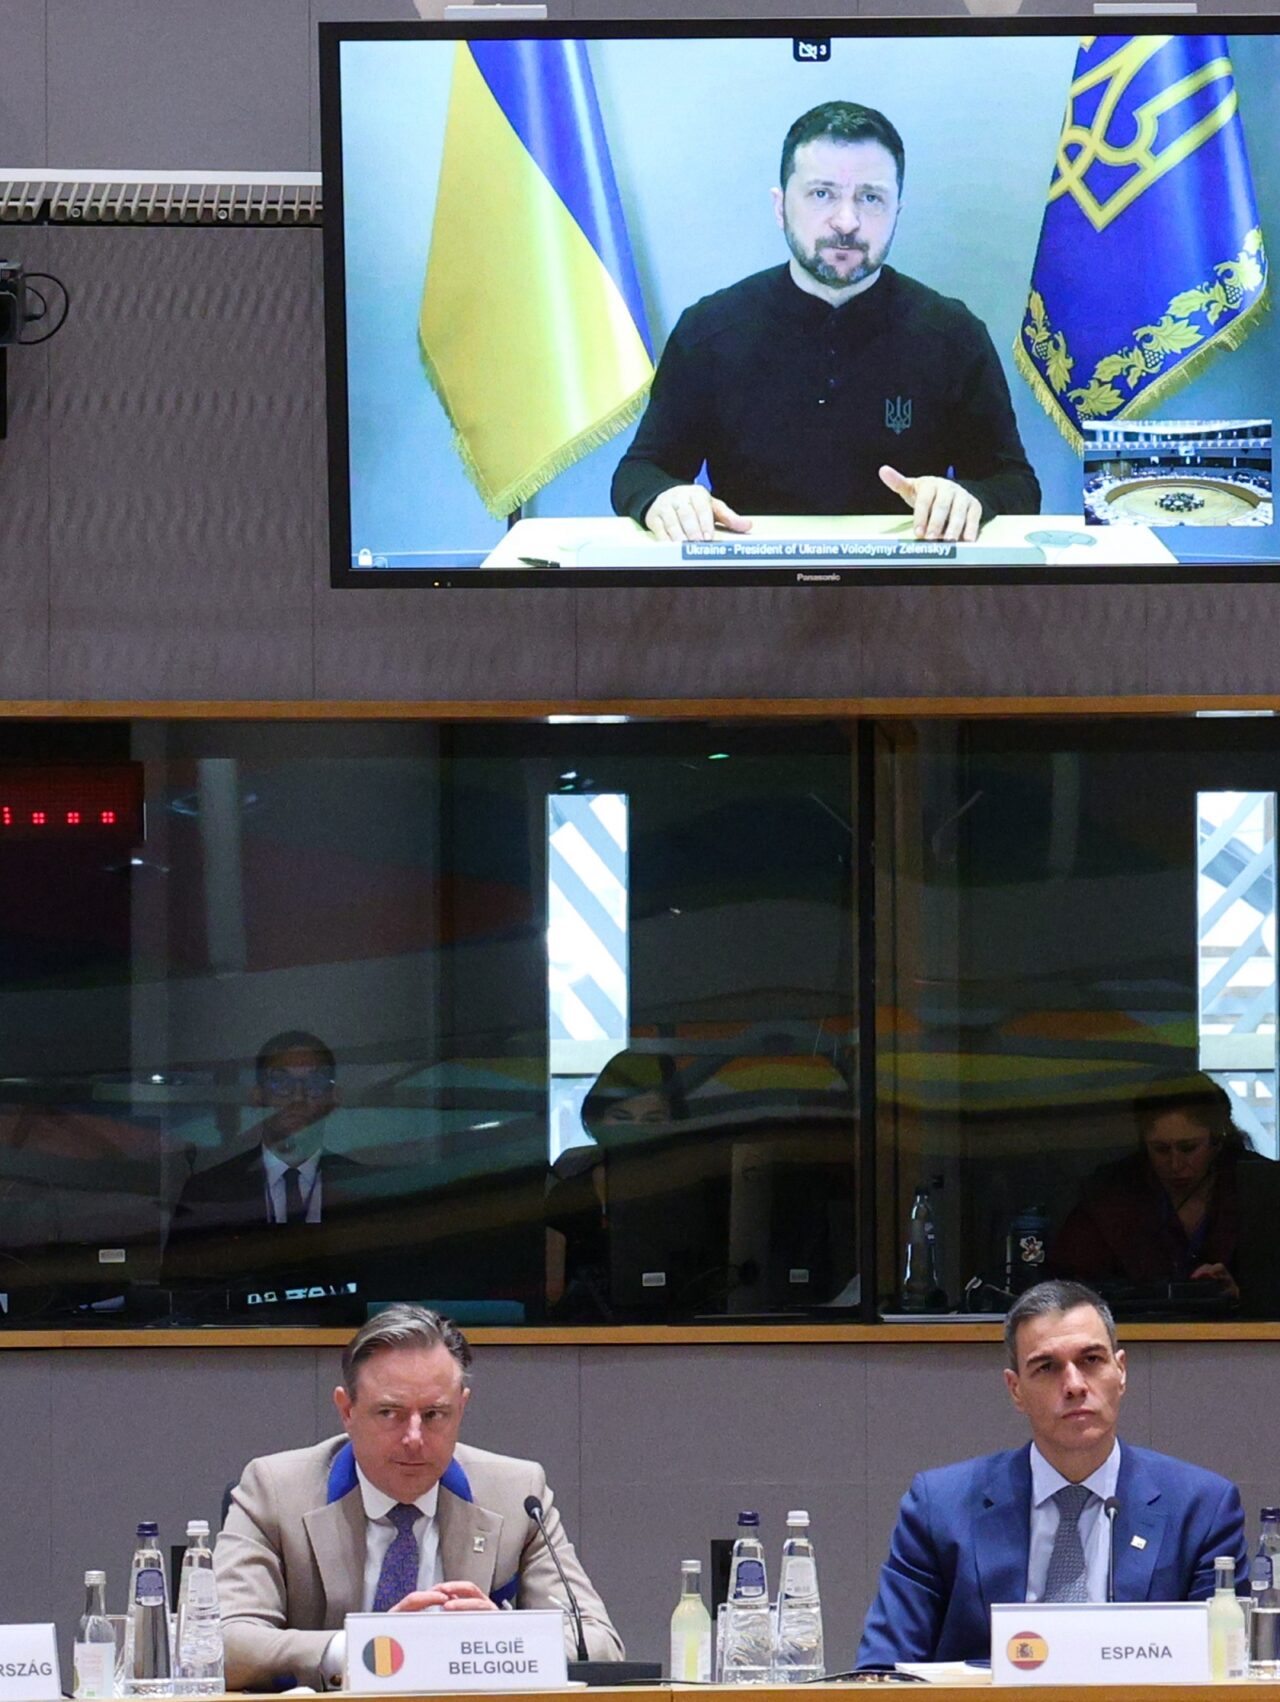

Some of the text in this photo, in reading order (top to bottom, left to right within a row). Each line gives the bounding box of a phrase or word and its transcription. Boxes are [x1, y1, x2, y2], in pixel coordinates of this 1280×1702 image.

[819, 44, 827, 56] 3
[686, 543, 727, 555] Ukraine
[733, 543, 783, 555] President
[784, 543, 797, 555] of
[799, 543, 839, 555] Ukraine
[840, 543, 897, 556] Volodymyr
[899, 543, 951, 556] Zelenskyy
[796, 573, 841, 581] Panasonic
[461, 1637, 524, 1655] BELGIË
[1100, 1643, 1173, 1660] ESPAÑA
[449, 1660, 539, 1675] BELGIQUE
